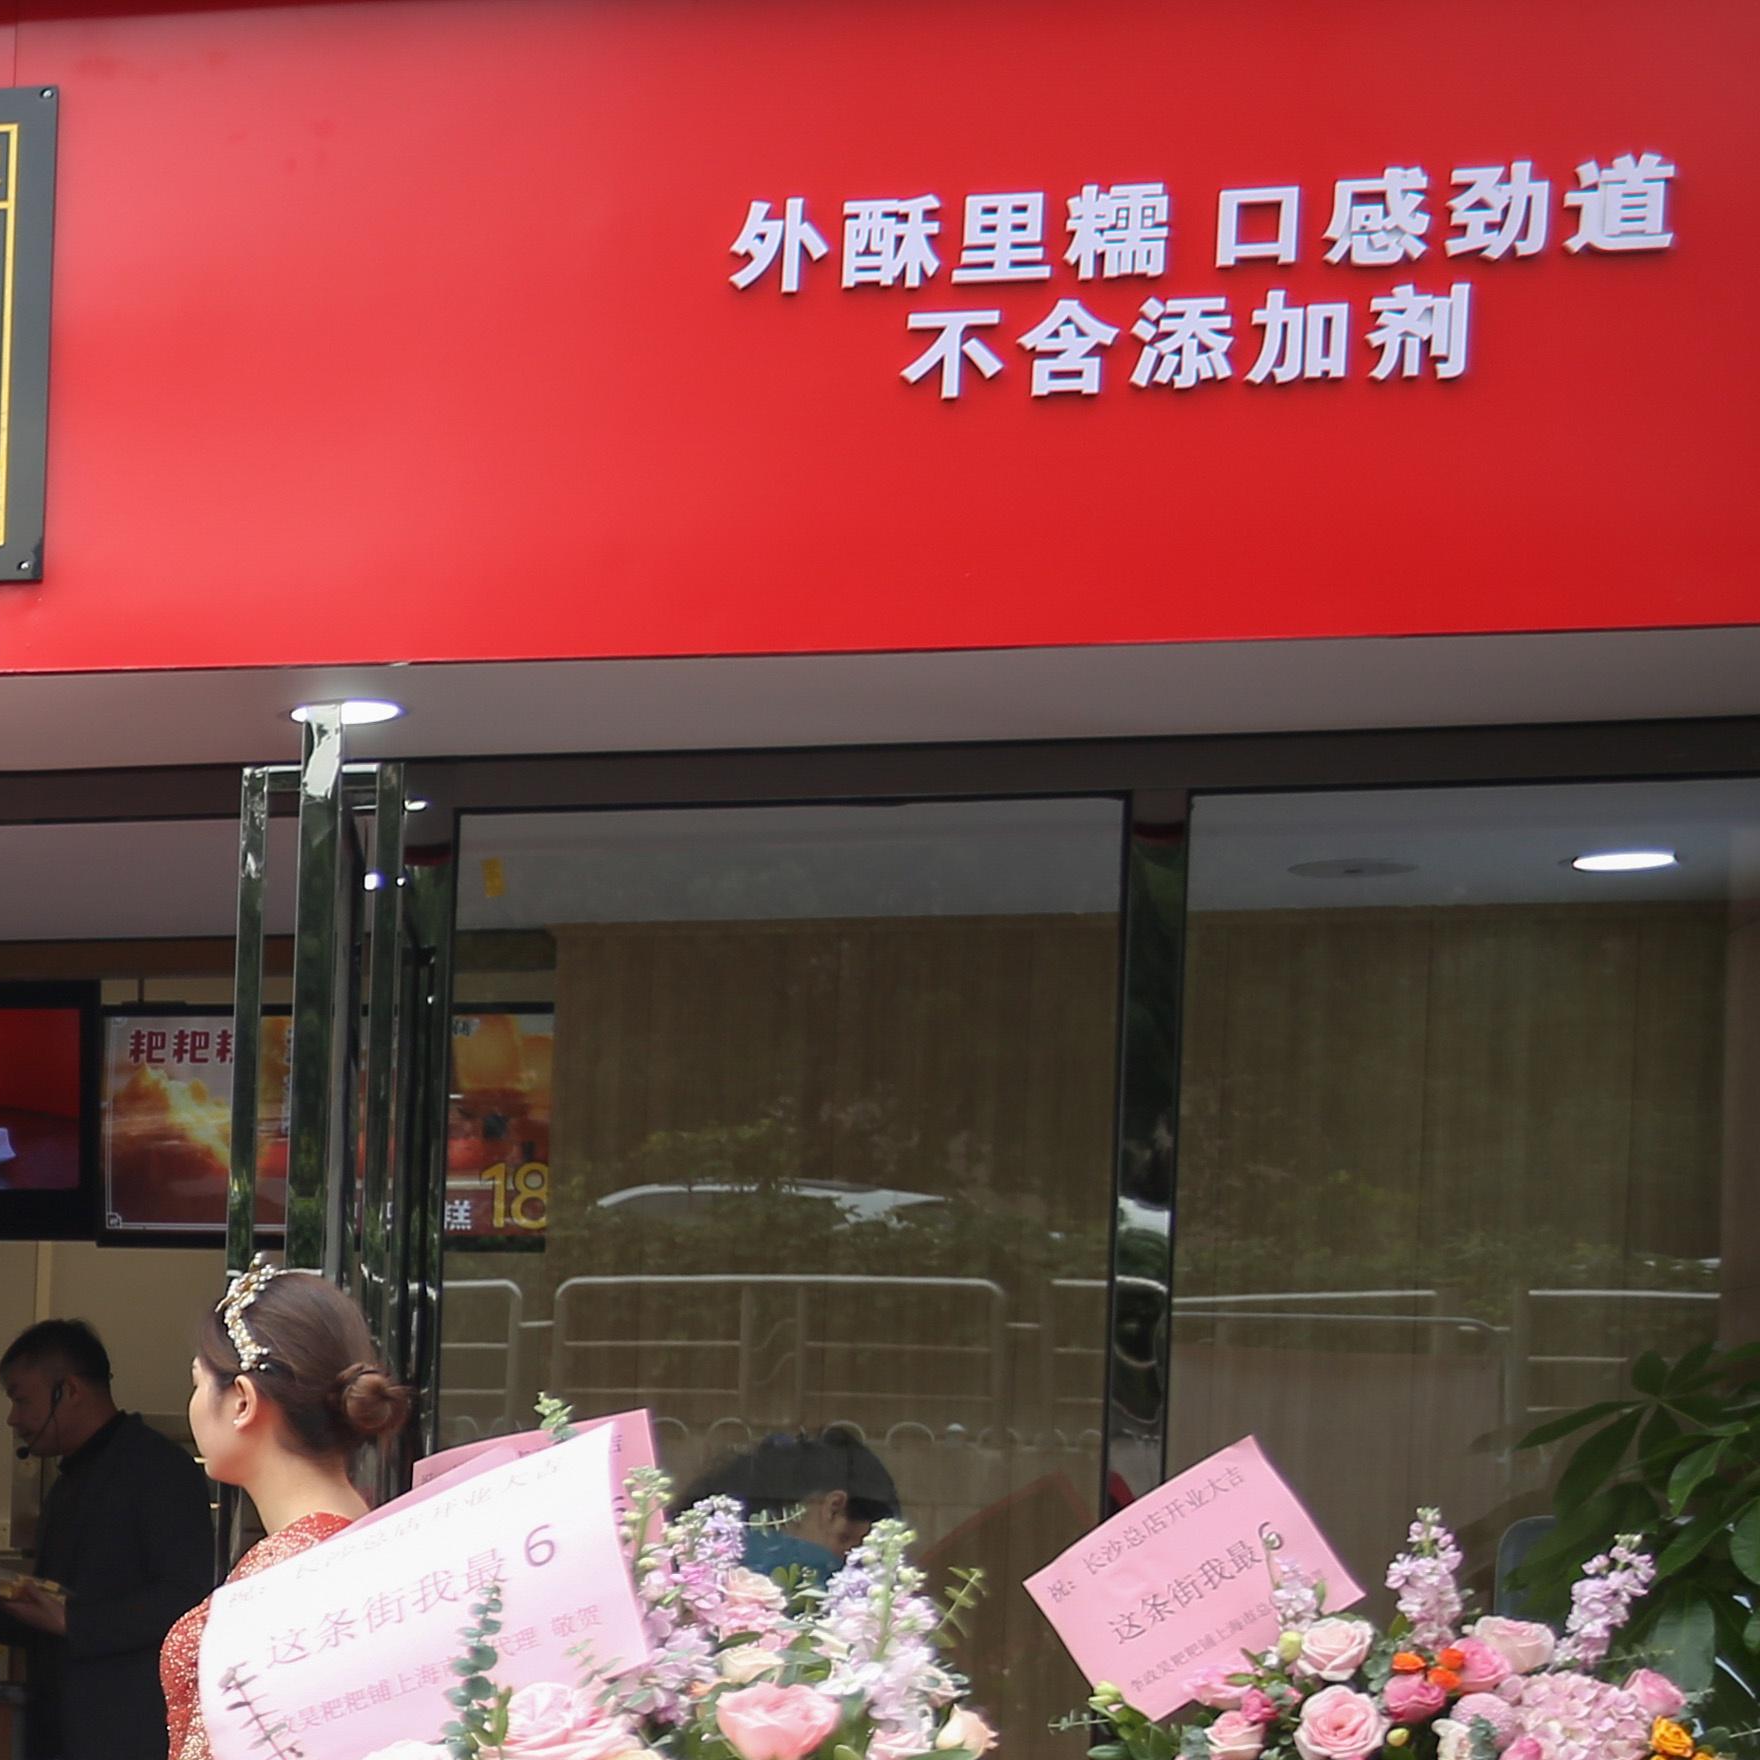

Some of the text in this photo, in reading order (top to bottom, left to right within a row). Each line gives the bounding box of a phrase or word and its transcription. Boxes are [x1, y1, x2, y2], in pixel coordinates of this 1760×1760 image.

[728, 151, 1678, 295] 外酥里糯 口感劲道
[900, 282, 1473, 399] 不含添加剂
[481, 1161, 550, 1230] 18
